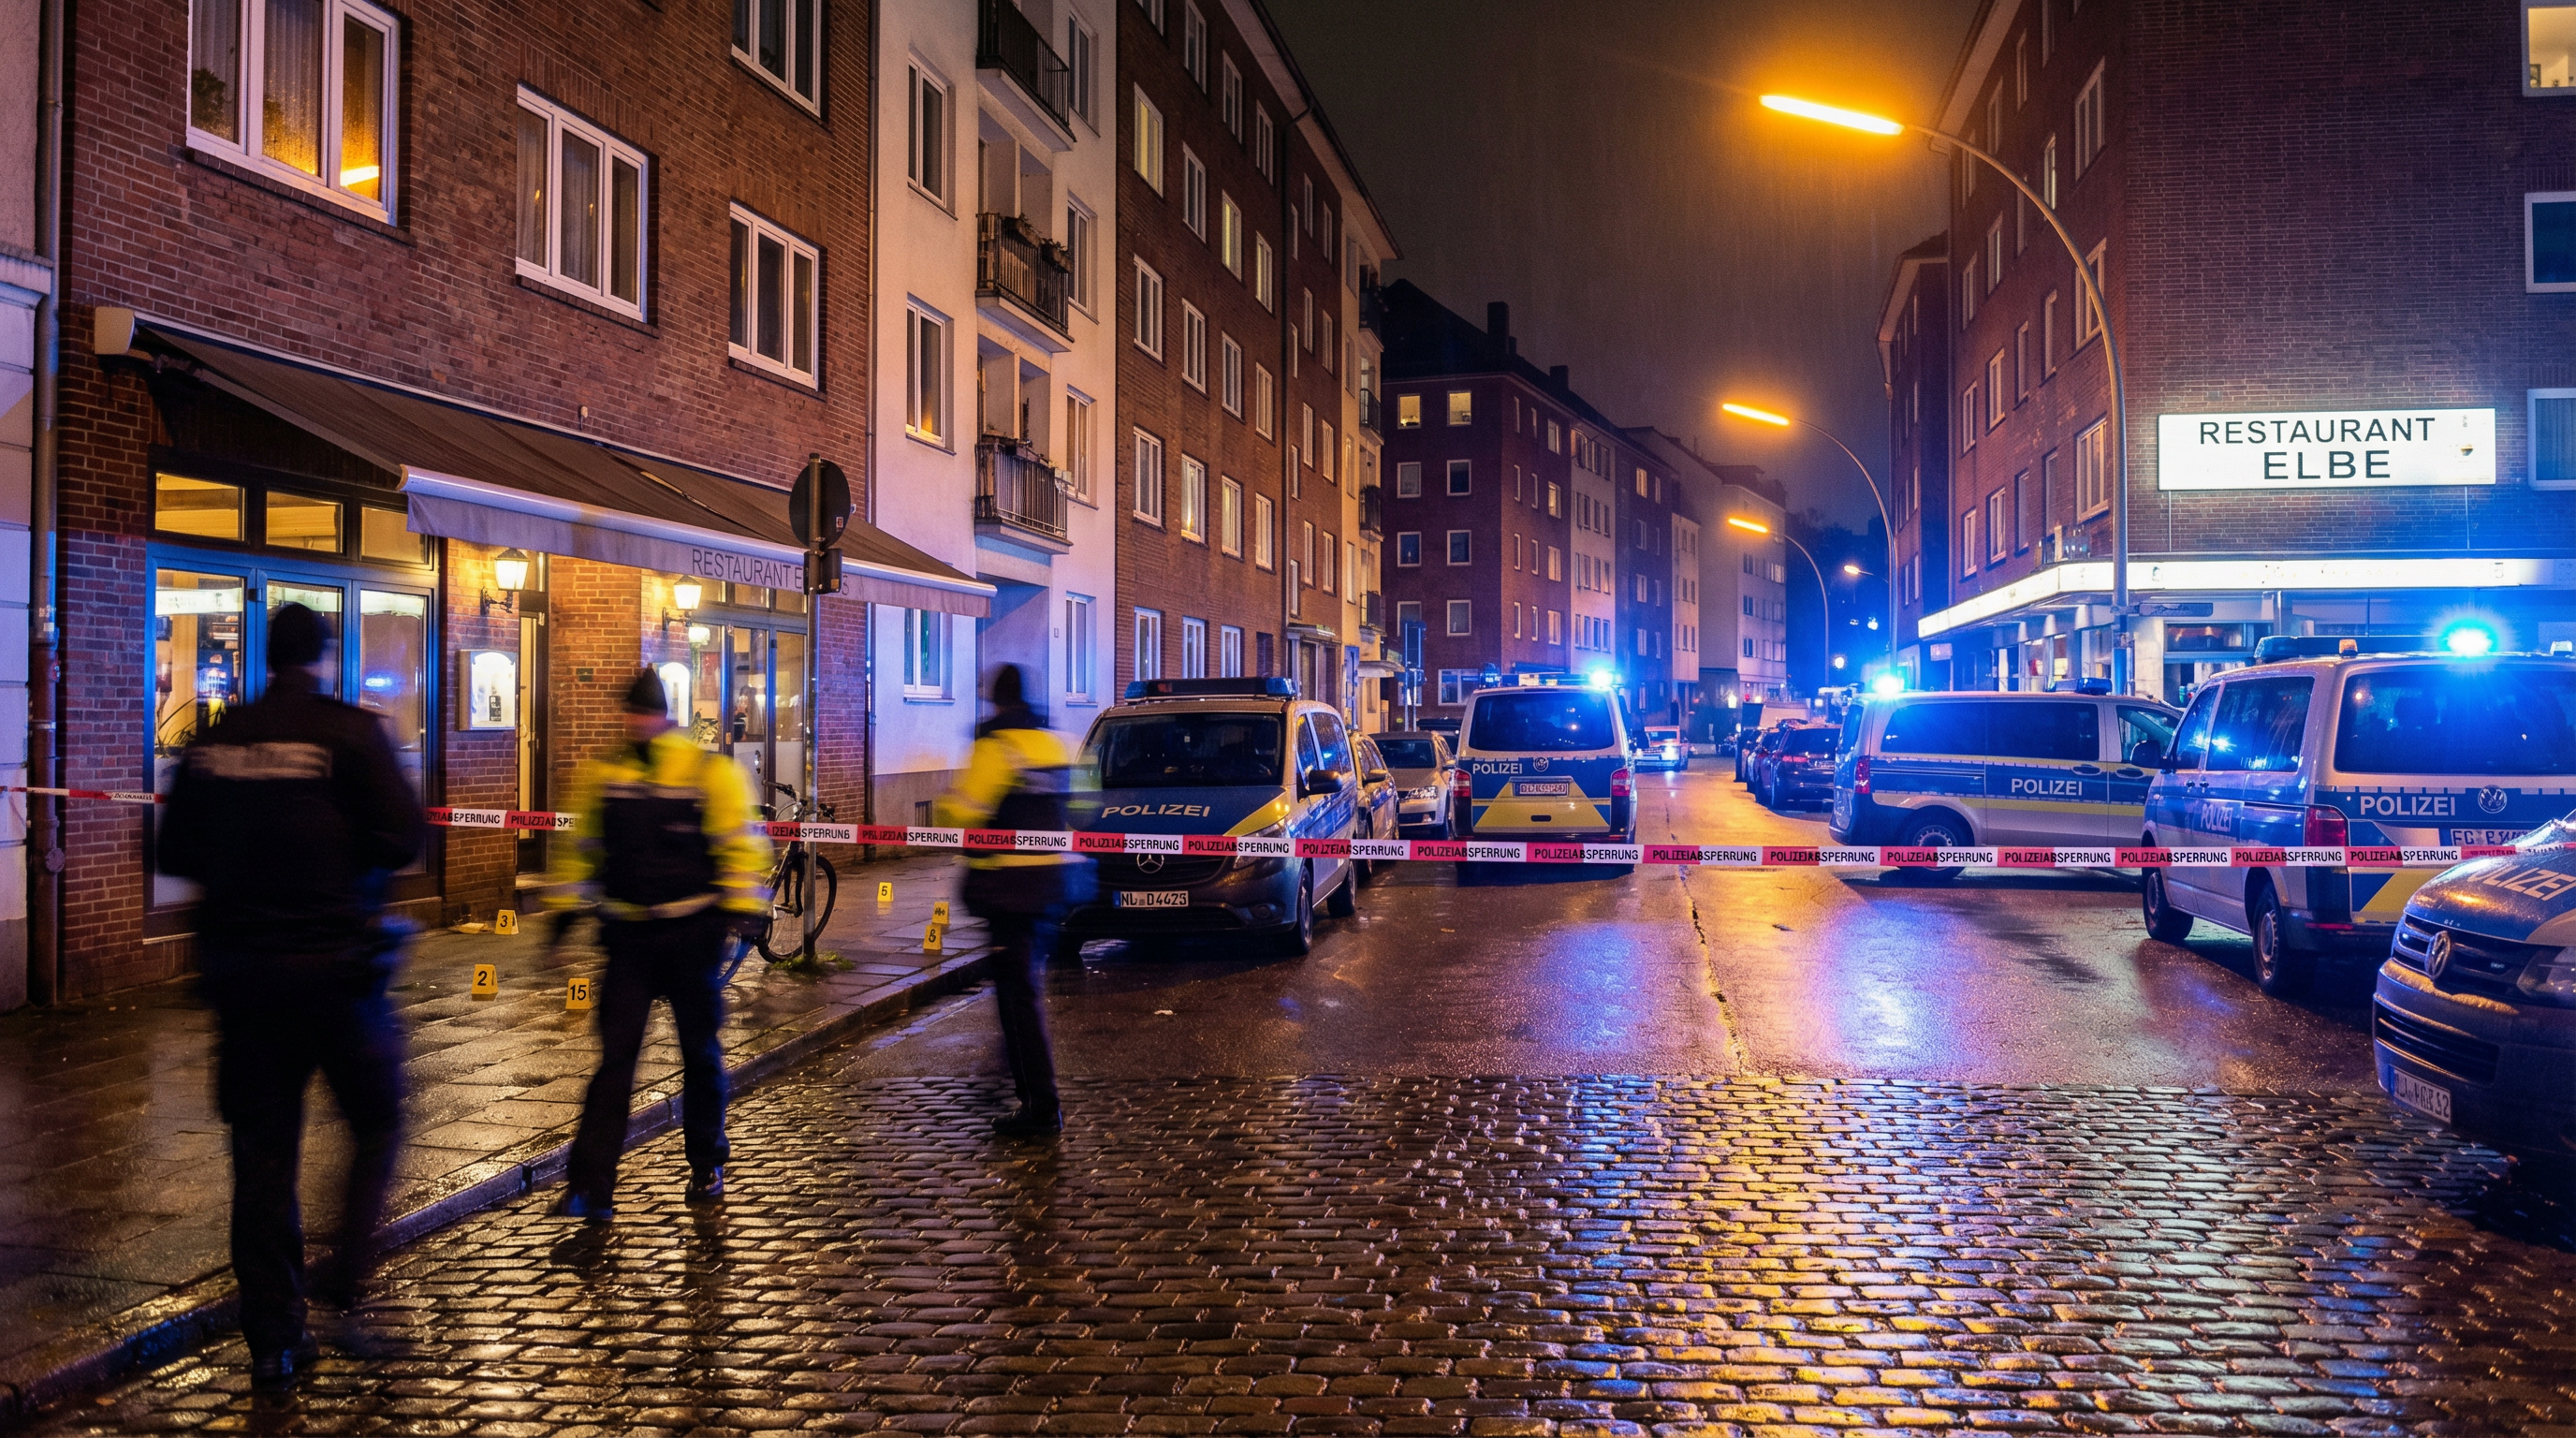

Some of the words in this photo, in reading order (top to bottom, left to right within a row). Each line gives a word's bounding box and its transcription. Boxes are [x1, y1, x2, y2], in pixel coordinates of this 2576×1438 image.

[2200, 417, 2436, 445] RESTAURANT
[2263, 449, 2391, 480] ELBE
[692, 548, 792, 588] RESTAURANT
[1472, 763, 1523, 775] POLIZEI
[2011, 778, 2083, 796] POLIZEI
[1101, 804, 1211, 819] POLIZEI
[2359, 796, 2456, 816] POLIZEI
[881, 886, 888, 896] 5
[500, 915, 508, 928] 3
[476, 970, 488, 987] 2
[570, 984, 587, 1001] 15
